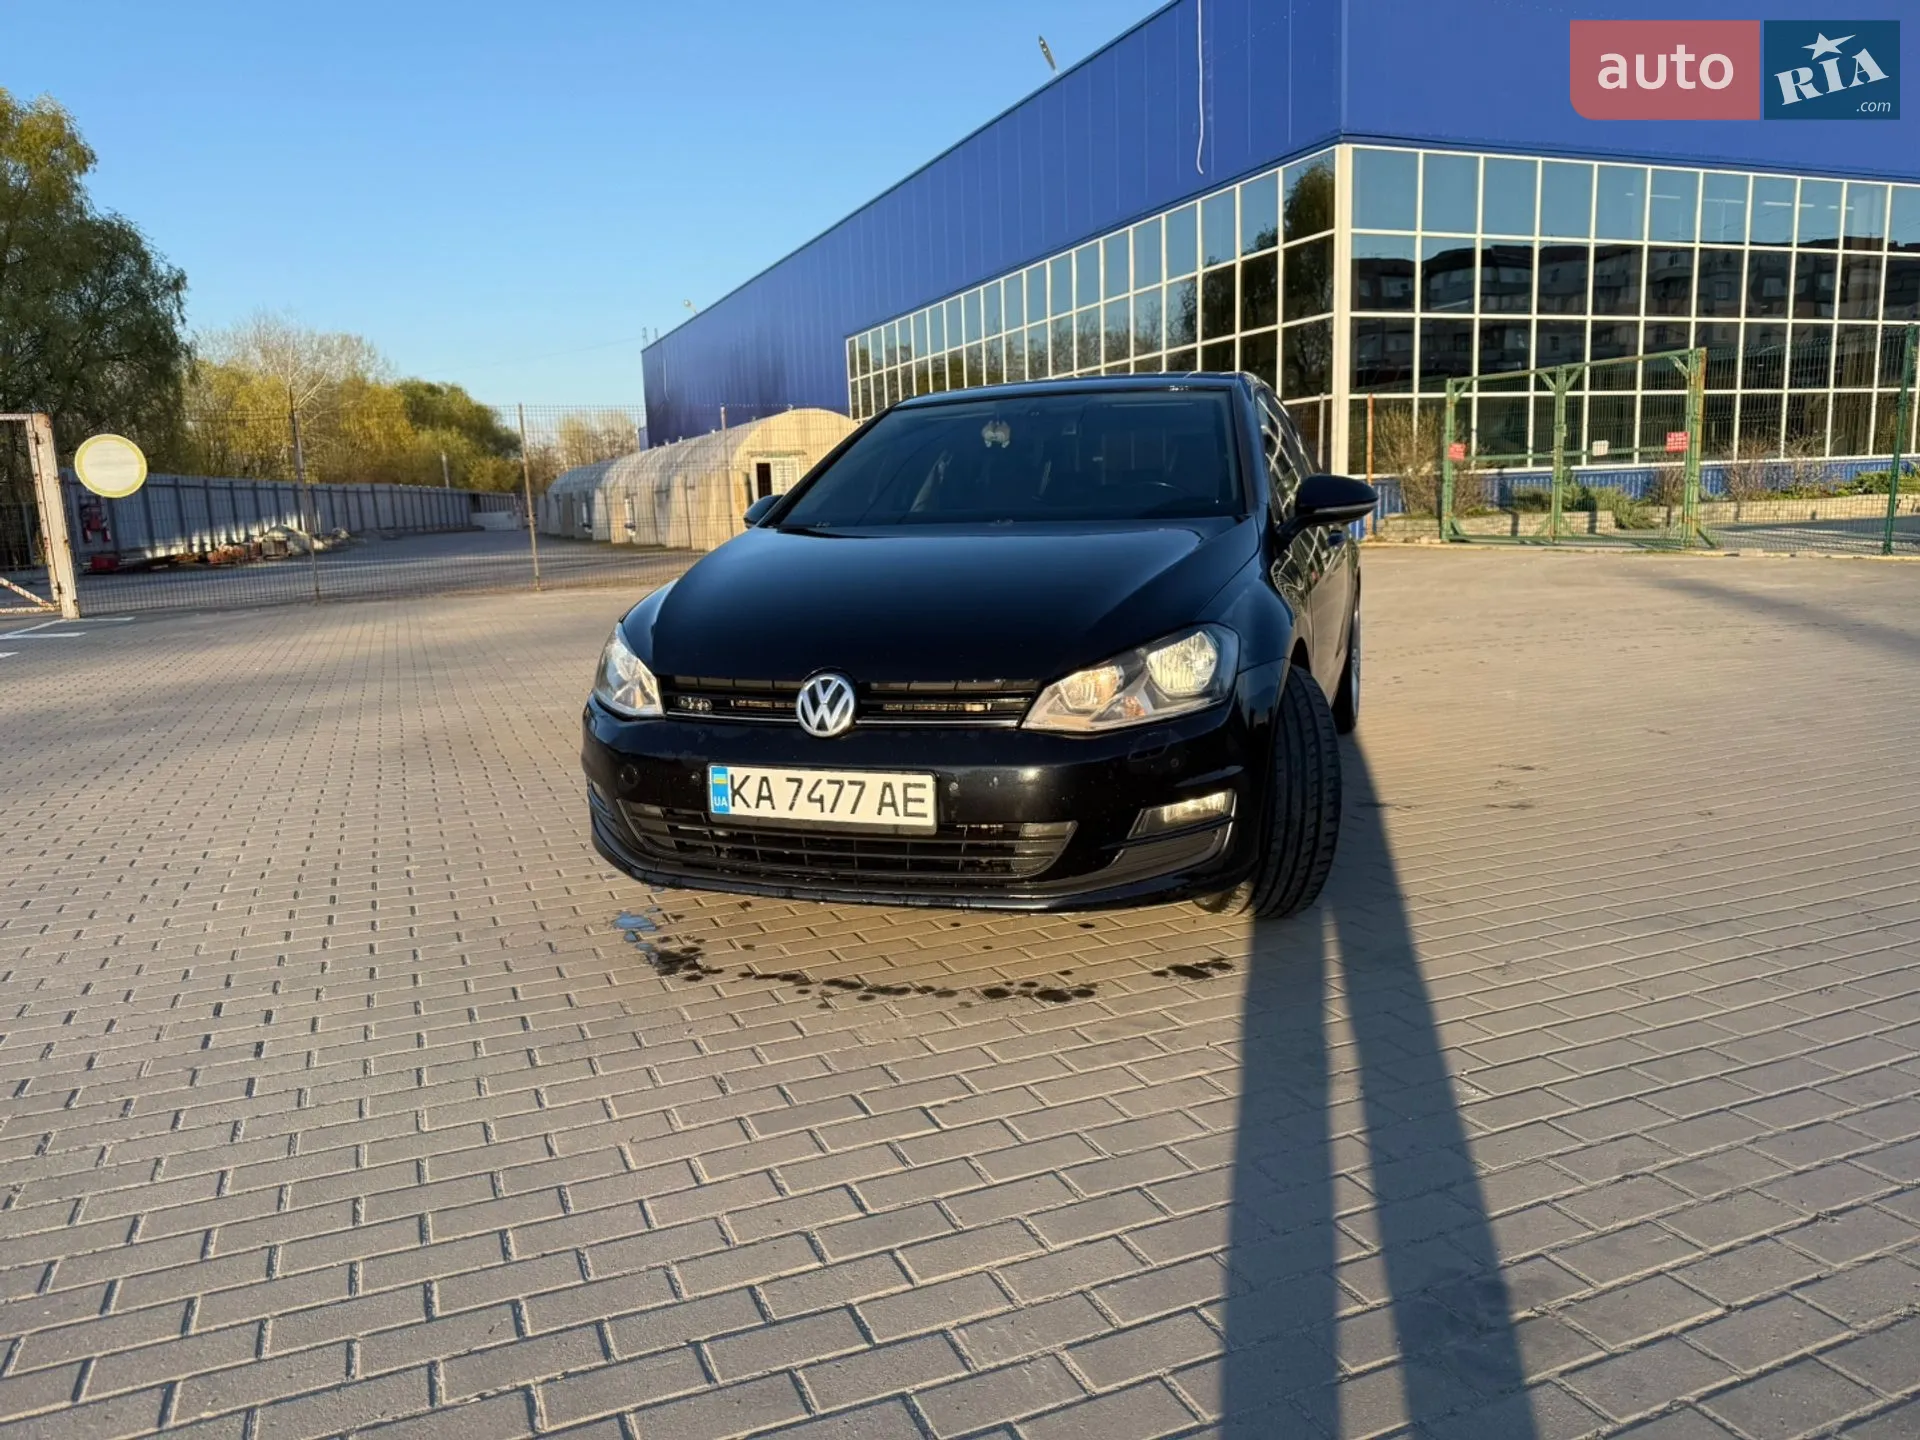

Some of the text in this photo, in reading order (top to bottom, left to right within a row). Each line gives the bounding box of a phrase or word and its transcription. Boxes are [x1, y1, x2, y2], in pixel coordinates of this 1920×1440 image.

[713, 795, 728, 807] UA
[730, 774, 928, 818] KA 7477 AE
